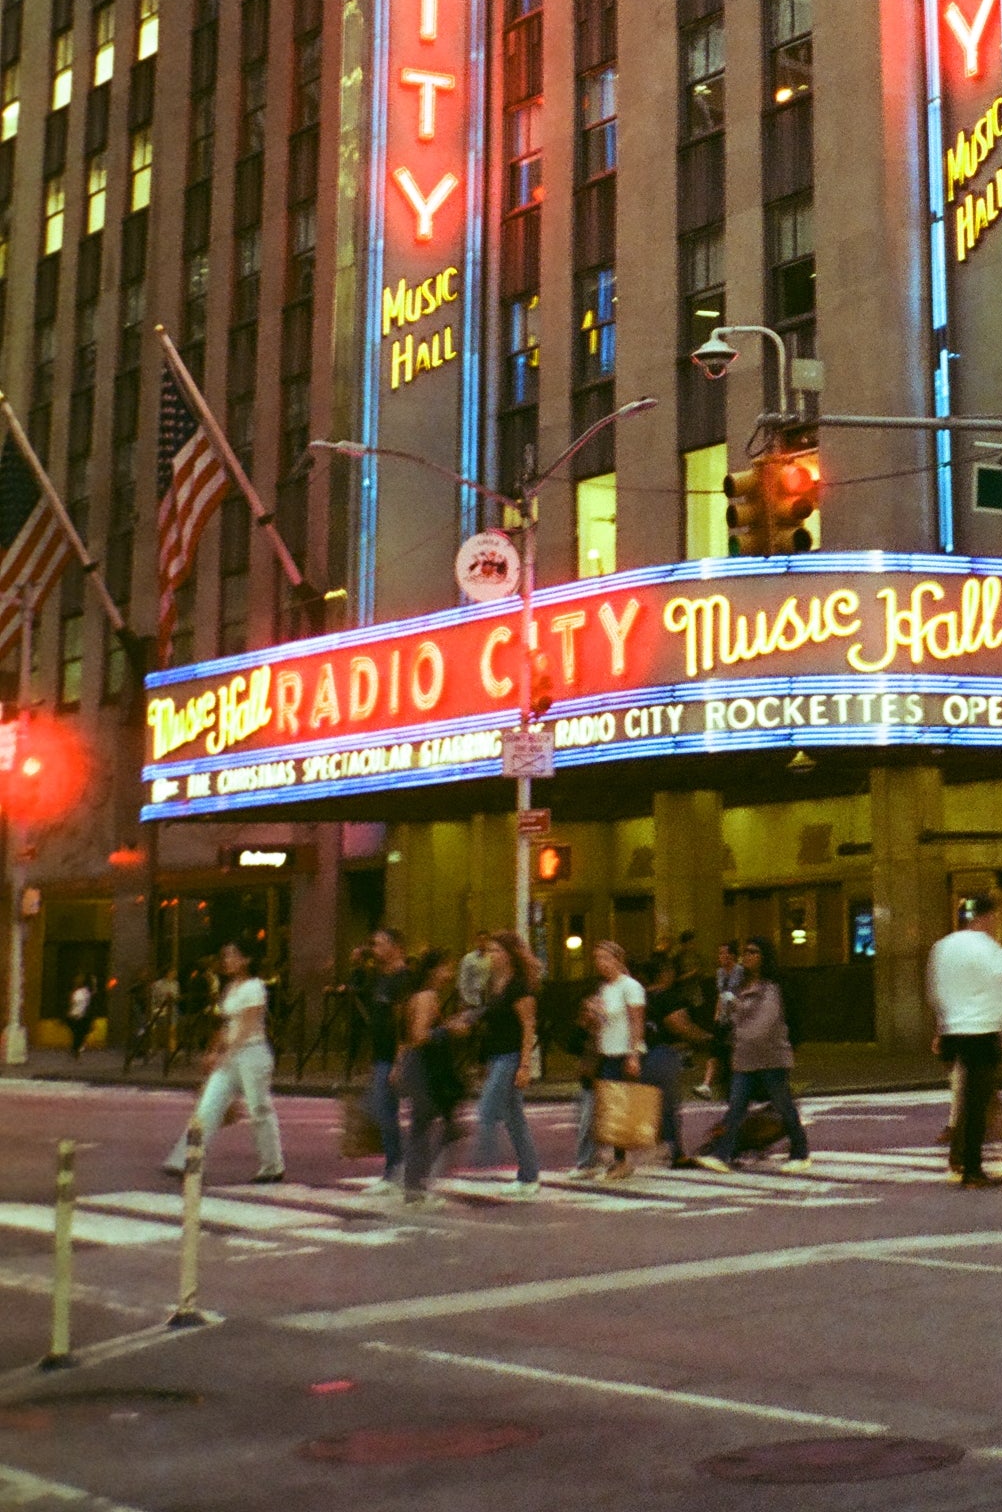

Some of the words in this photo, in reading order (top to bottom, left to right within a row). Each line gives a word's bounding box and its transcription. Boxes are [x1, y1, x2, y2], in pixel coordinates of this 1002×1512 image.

[664, 593, 861, 677] Music
[207, 665, 272, 755] Hall
[276, 640, 445, 735] RADIO
[302, 743, 412, 783] SPECTACULAR
[554, 712, 616, 748] RADIO
[625, 704, 685, 738] CITY
[705, 692, 925, 732] ROCKETTES
